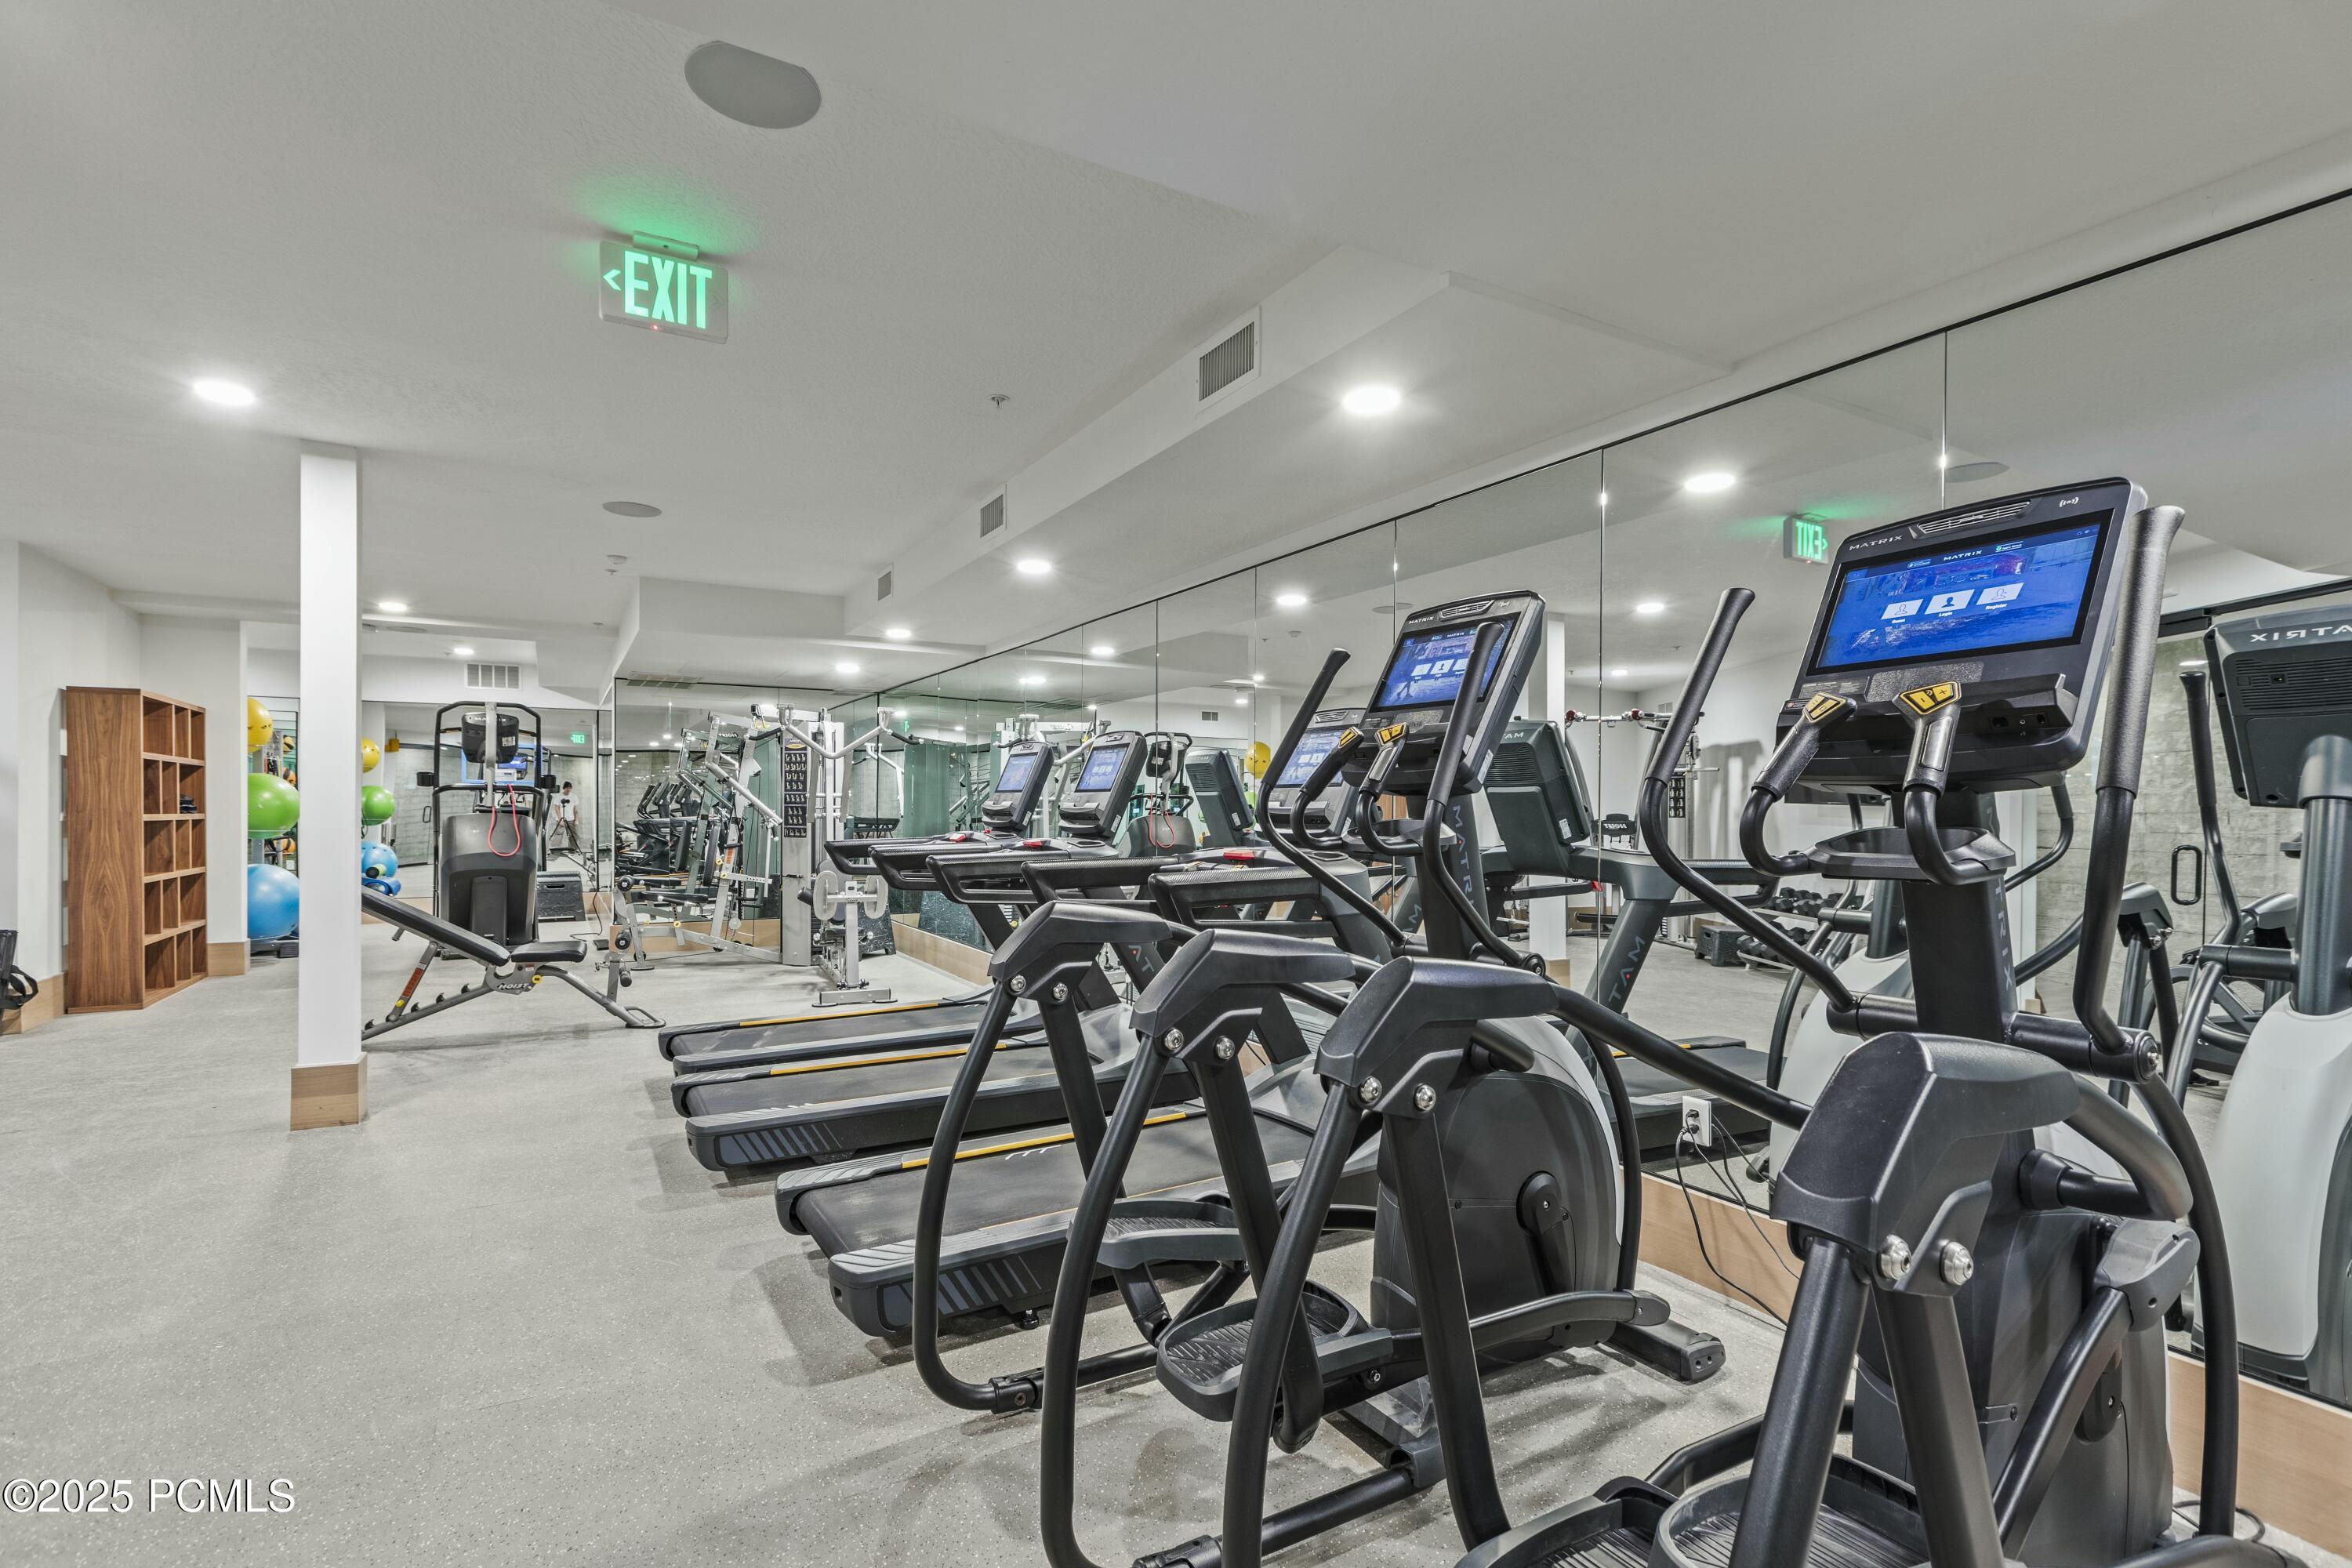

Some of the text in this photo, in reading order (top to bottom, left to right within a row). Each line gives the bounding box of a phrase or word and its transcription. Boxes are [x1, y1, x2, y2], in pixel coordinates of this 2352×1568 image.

[624, 250, 713, 329] EXIT
[1849, 535, 1903, 551] MATRIX
[1943, 550, 1983, 561] MATRIX
[1408, 616, 1435, 625] MATRIX
